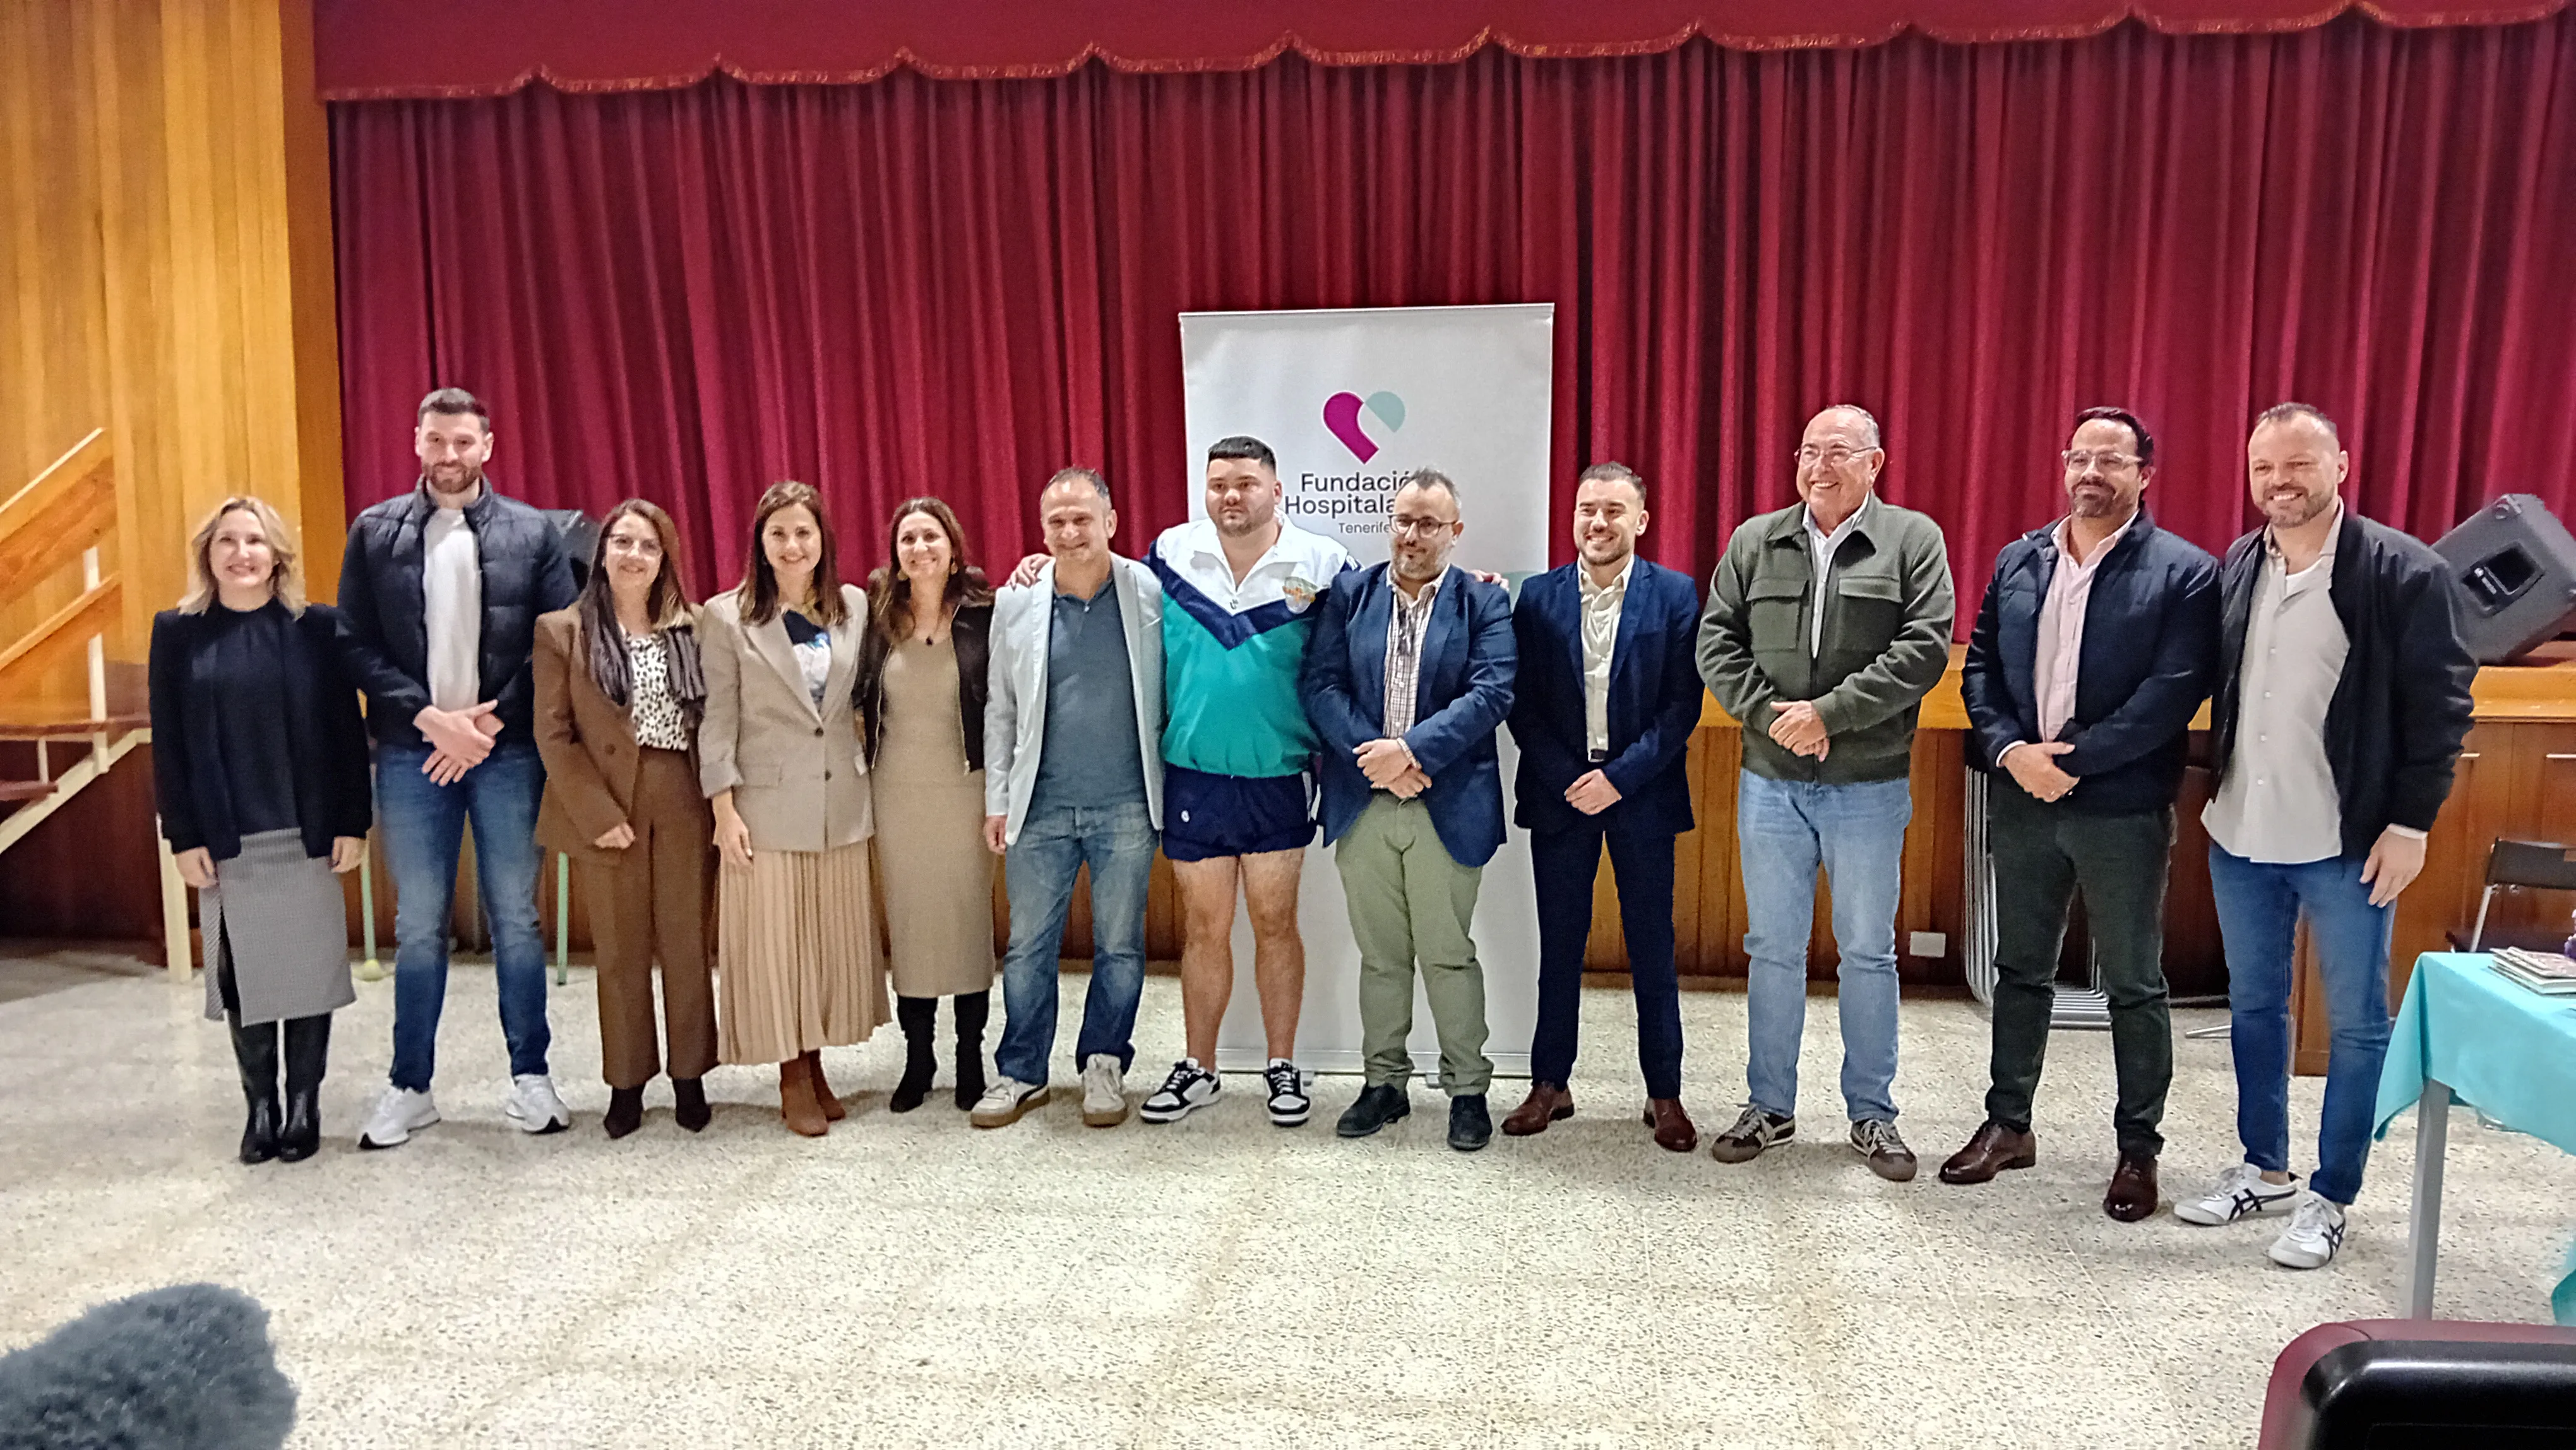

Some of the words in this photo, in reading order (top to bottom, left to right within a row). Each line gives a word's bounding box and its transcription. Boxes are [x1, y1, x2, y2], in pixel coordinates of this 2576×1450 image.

[1301, 470, 1409, 492] Fundació
[1284, 493, 1395, 519] Hospitala
[1338, 521, 1390, 534] Tenerife
